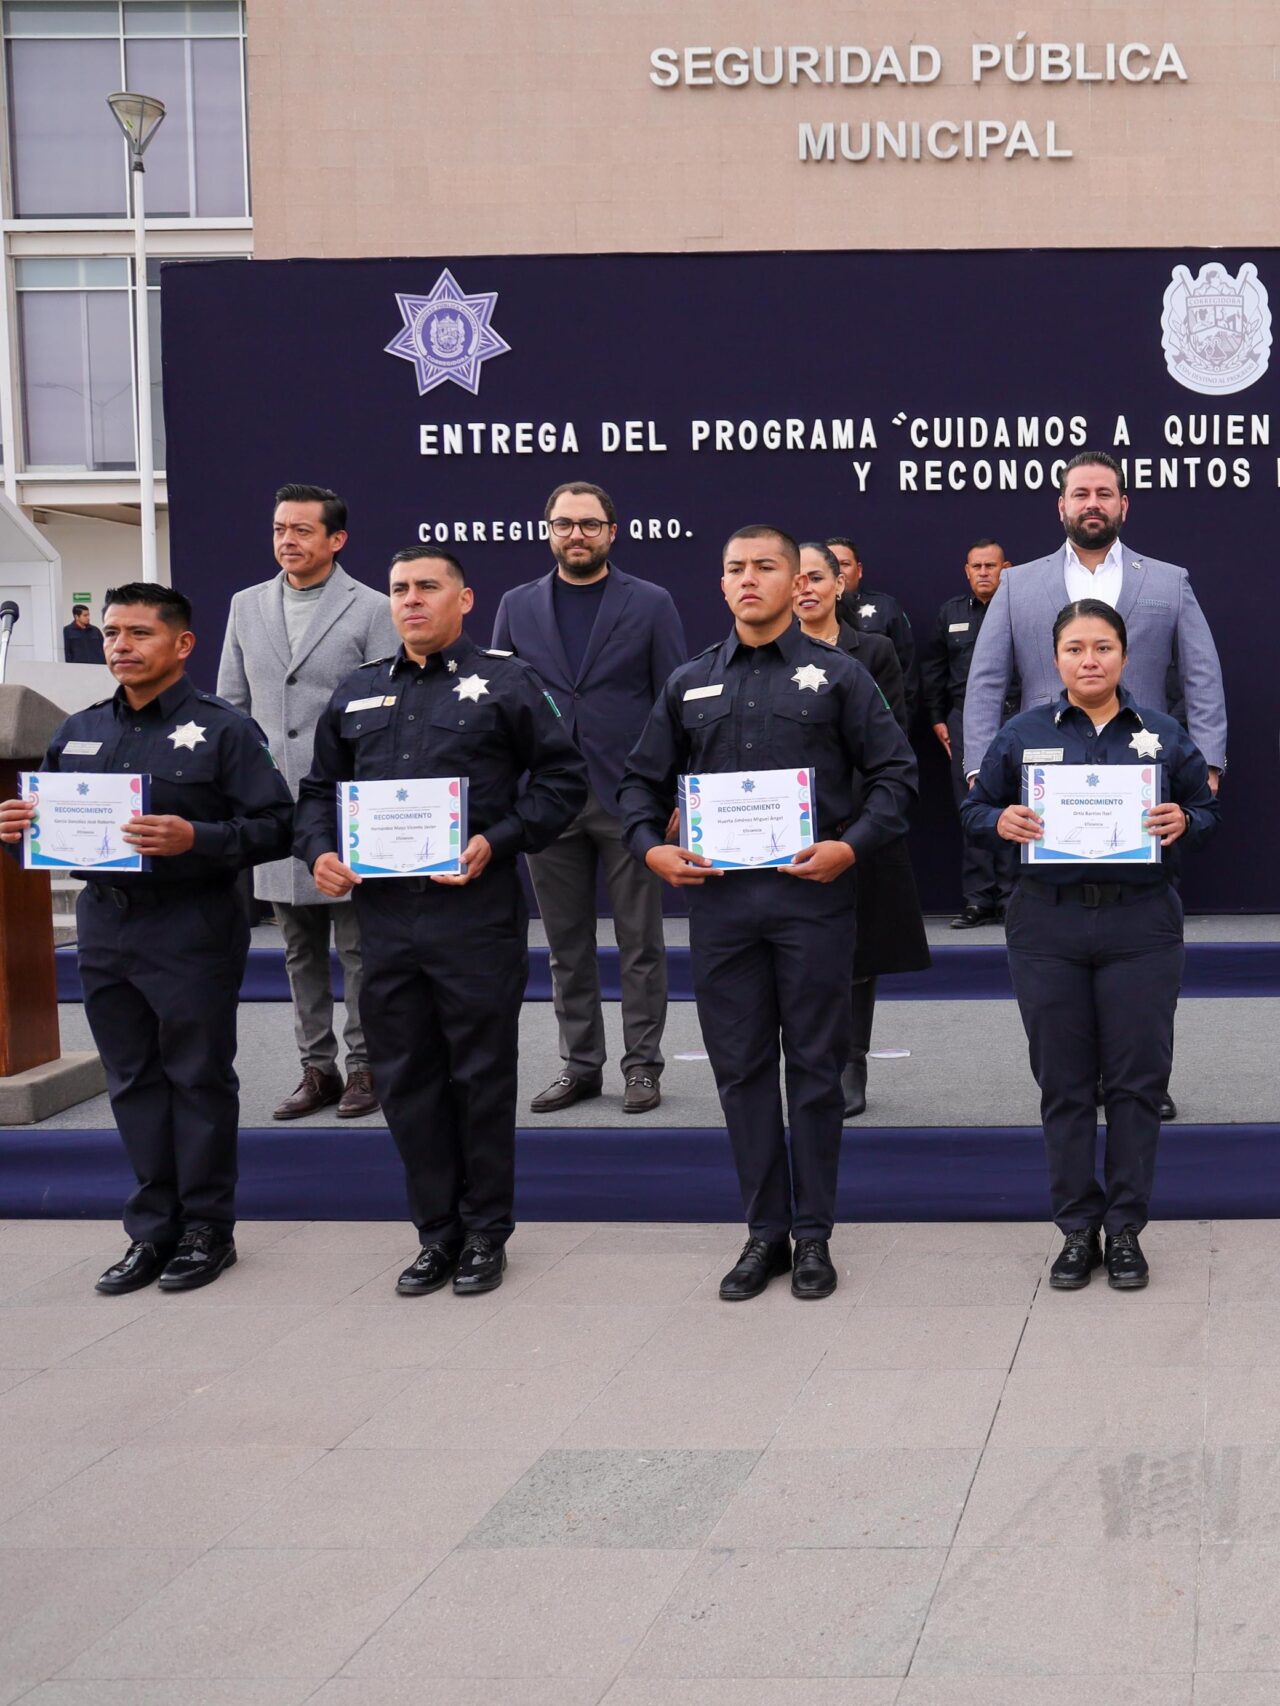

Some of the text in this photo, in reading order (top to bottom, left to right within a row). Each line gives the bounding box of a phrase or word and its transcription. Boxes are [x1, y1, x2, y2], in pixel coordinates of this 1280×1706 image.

[649, 31, 1188, 87] SEGURIDAD PÚBLICA
[797, 120, 1073, 162] MUNICIPAL
[1189, 297, 1241, 306] CORREGIDORA
[420, 422, 579, 455] ENTREGA
[602, 421, 667, 452] DEL
[691, 417, 879, 451] PROGRAMA
[1113, 415, 1131, 446] A
[1164, 415, 1270, 448] QUIEN
[852, 461, 872, 492] Y
[900, 457, 1251, 491] RECONOCIENTOS
[418, 518, 693, 542] CORREGID QRO.
[54, 806, 113, 814] RECONOCIMIENTO
[373, 812, 432, 821] RECONOCIMIENTO
[718, 803, 781, 813] RECONOCIMIENTO
